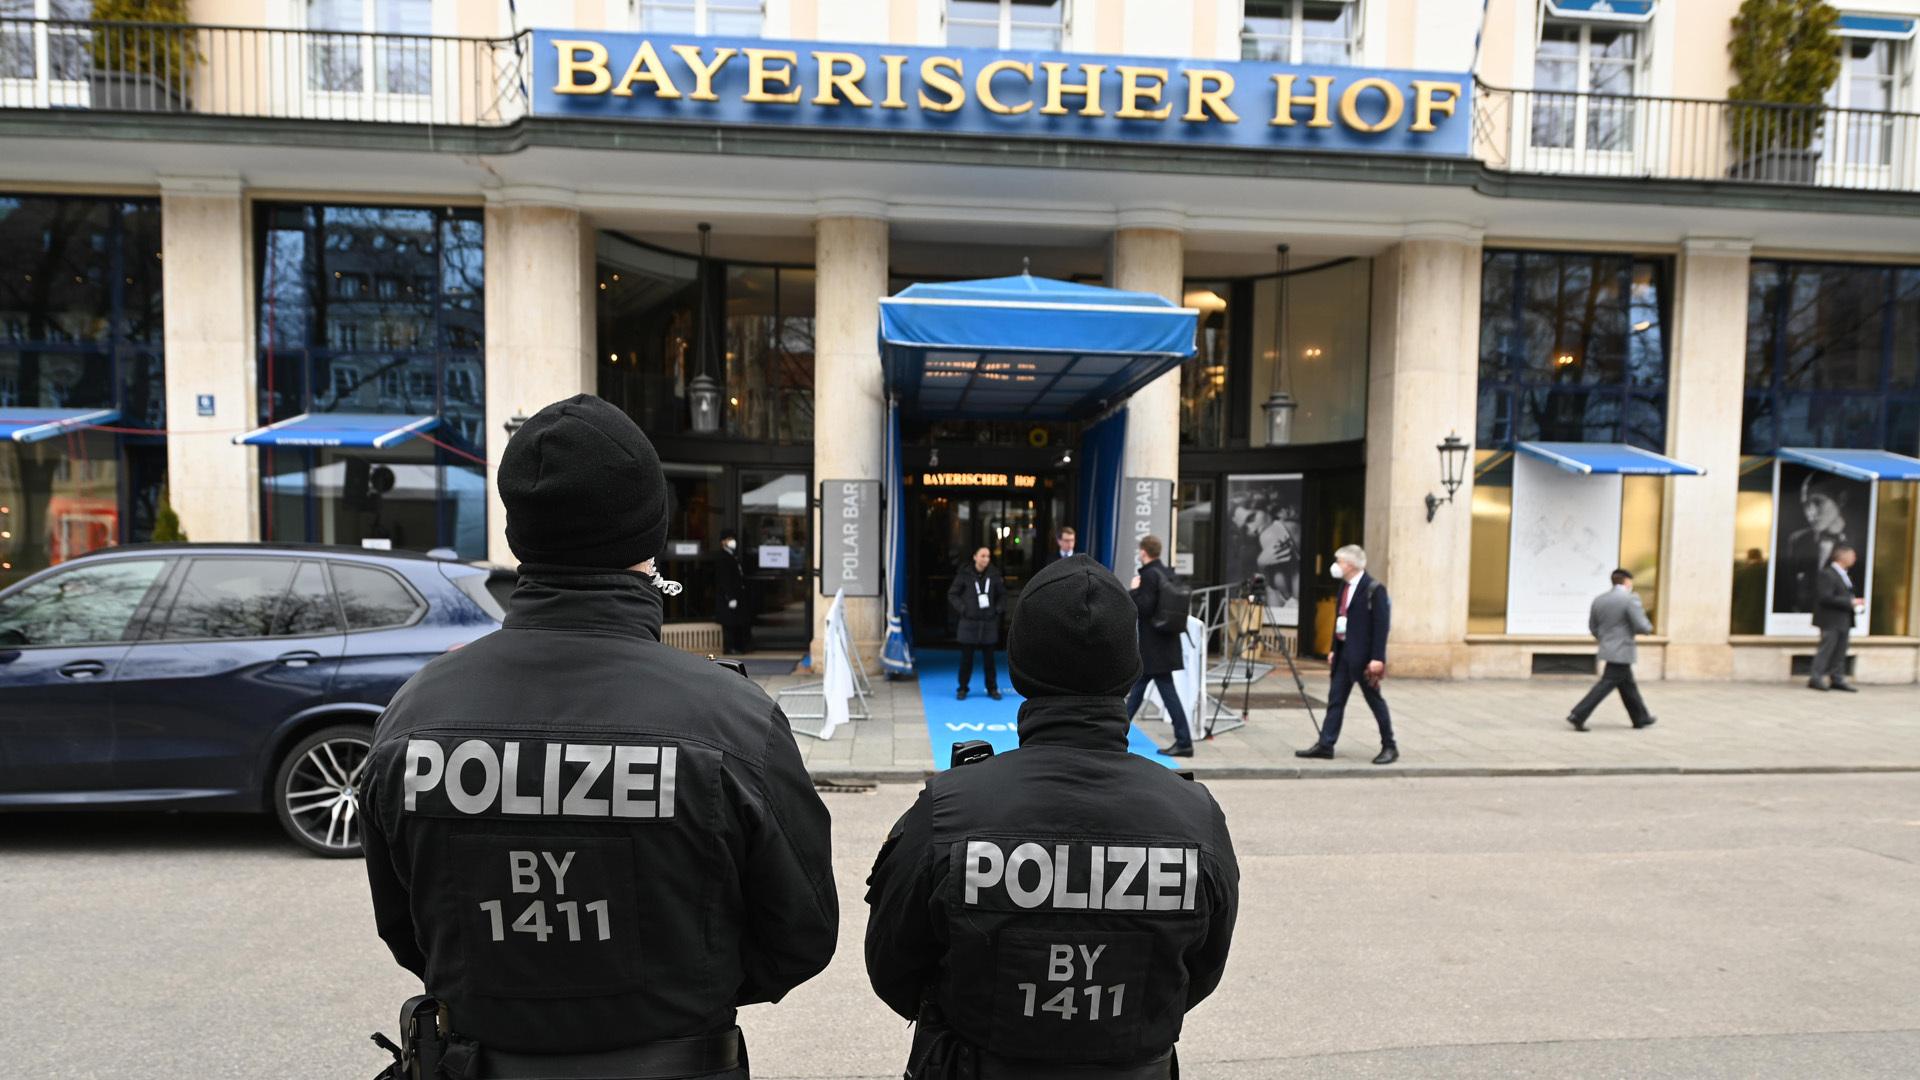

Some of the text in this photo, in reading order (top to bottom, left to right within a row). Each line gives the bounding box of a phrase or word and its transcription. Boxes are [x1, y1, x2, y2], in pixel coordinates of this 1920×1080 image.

[552, 39, 1462, 134] BAYERISCHER HOF
[923, 473, 1036, 487] BAYERISCHER HOF
[1136, 481, 1152, 516] BAR
[842, 482, 859, 580] POLAR BAR
[944, 722, 1018, 732] Wel
[403, 738, 678, 818] POLIZEI
[509, 850, 576, 895] BY
[964, 840, 1199, 911] POLIZEI
[479, 899, 611, 942] 1411
[1047, 944, 1107, 982] BY
[1018, 983, 1126, 1021] 1411
